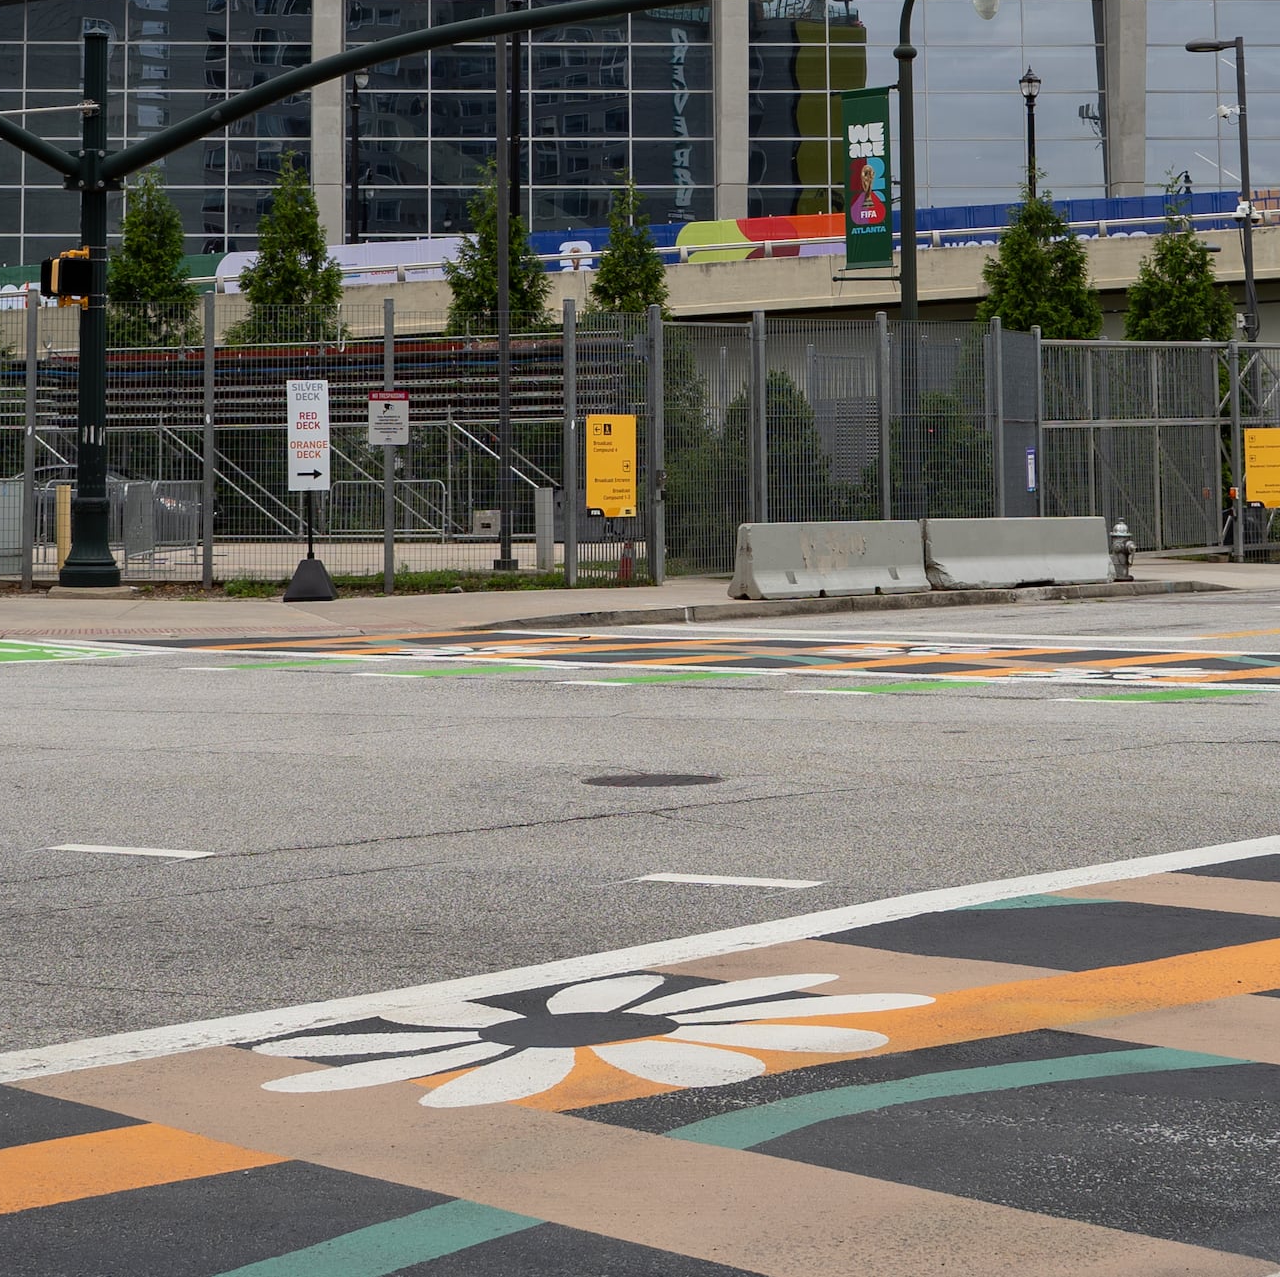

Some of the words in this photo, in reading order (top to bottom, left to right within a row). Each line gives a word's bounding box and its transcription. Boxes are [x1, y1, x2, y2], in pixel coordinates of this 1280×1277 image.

[848, 122, 885, 144] WE
[860, 210, 877, 219] FIFA
[851, 226, 887, 235] ATLANTA
[291, 383, 324, 392] SILVER
[295, 393, 320, 401] DECK
[299, 412, 317, 420] RED
[296, 422, 321, 430] DECK
[290, 441, 328, 449] ORANGE
[297, 451, 321, 459] DECK
